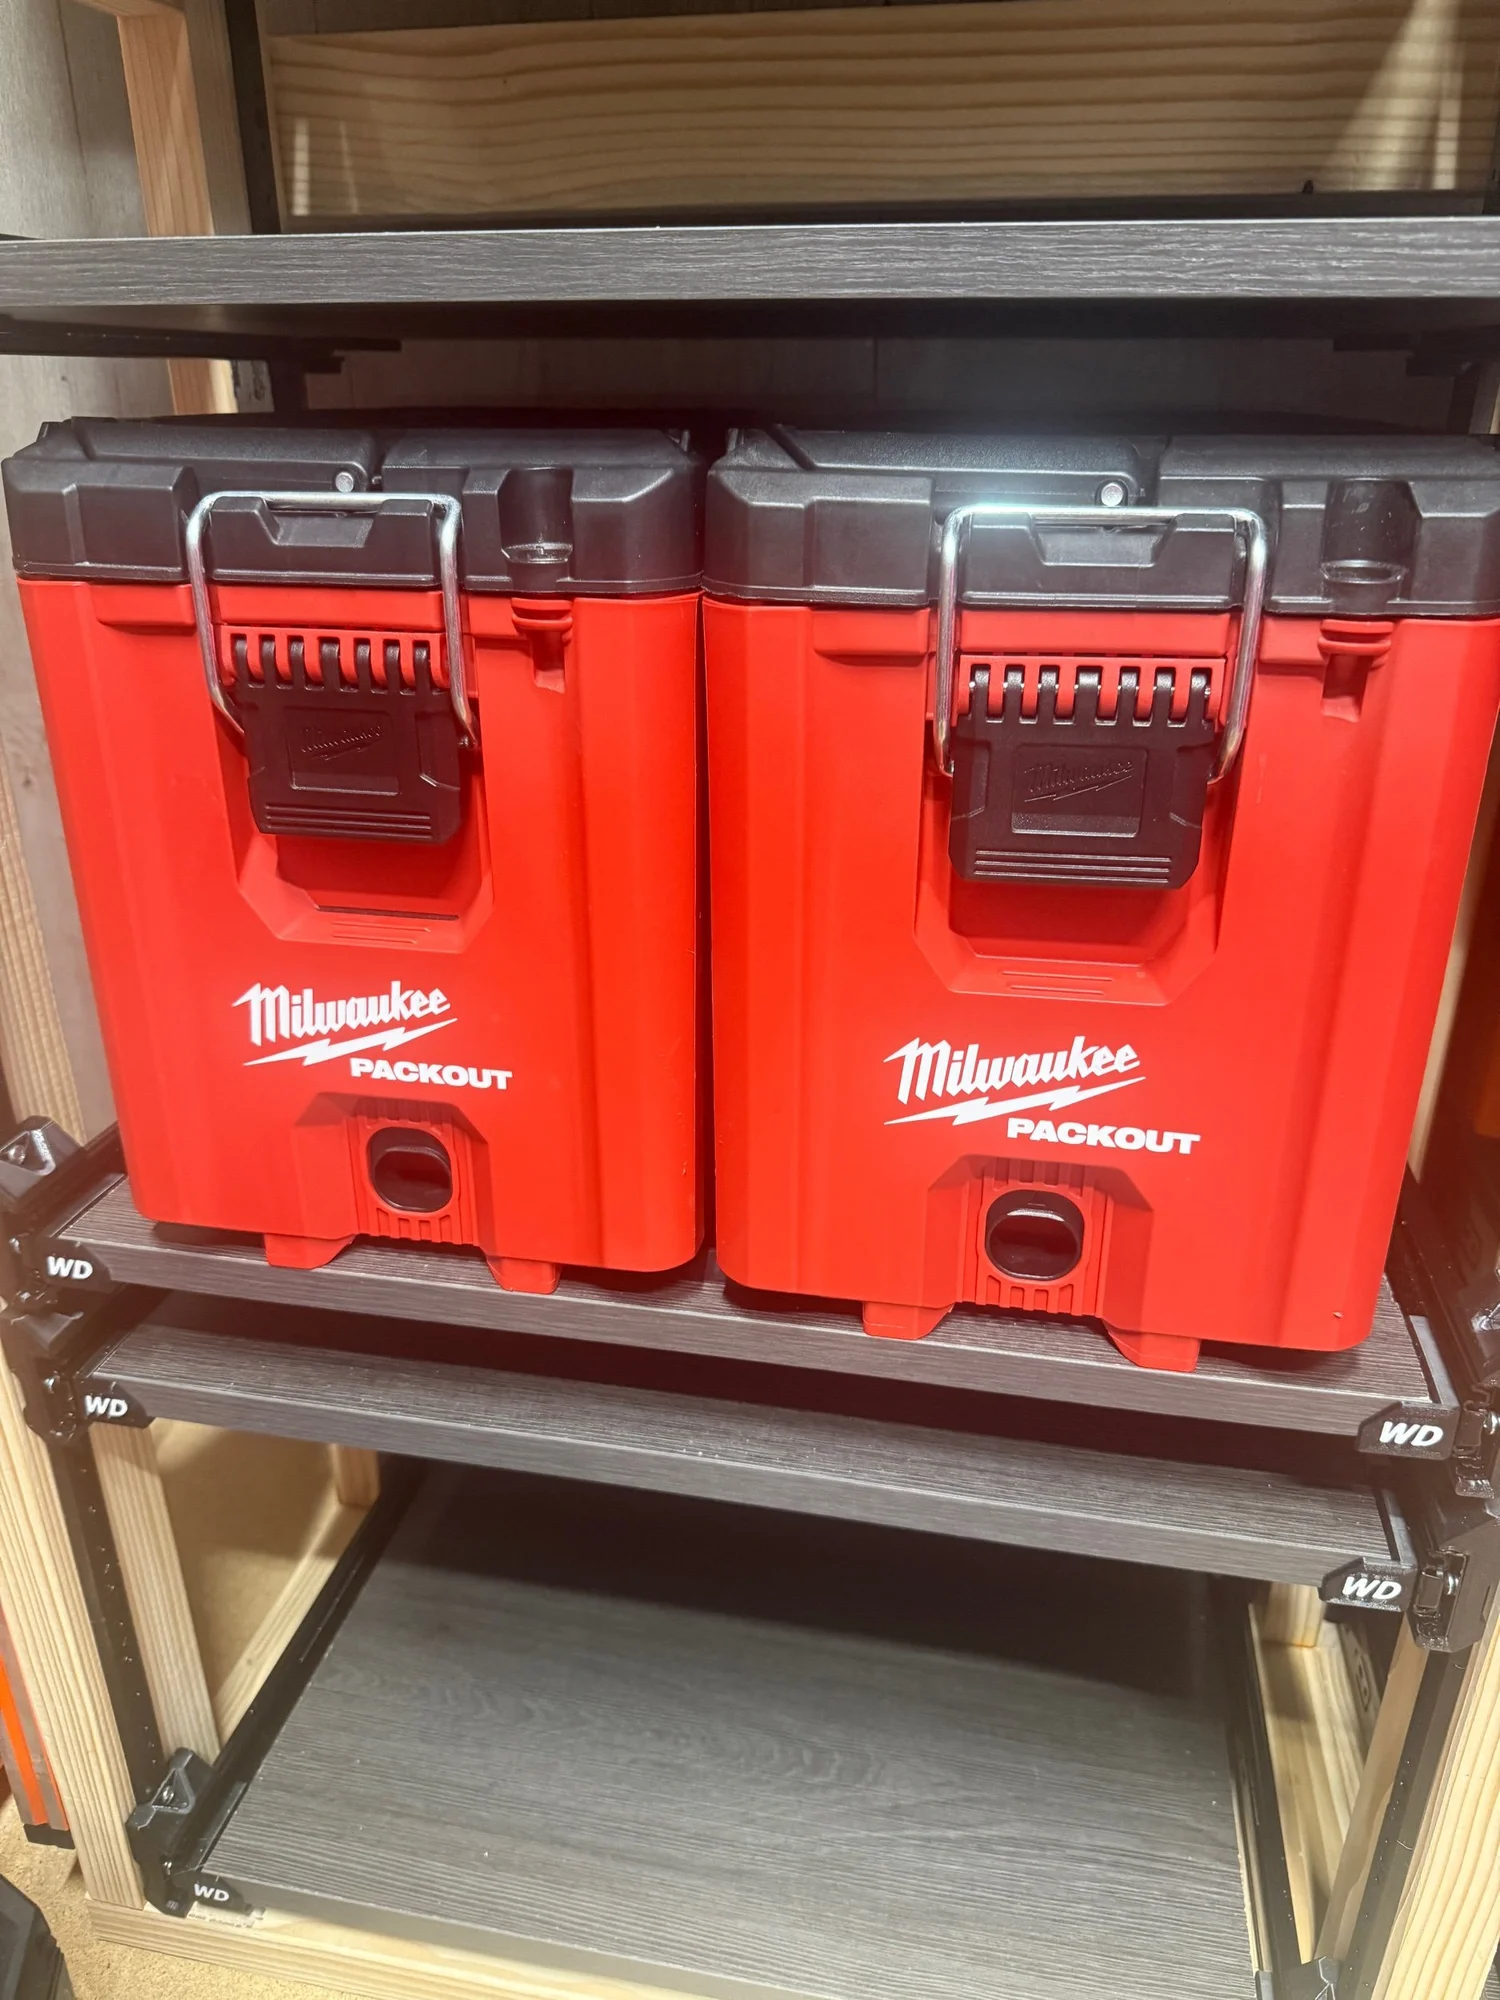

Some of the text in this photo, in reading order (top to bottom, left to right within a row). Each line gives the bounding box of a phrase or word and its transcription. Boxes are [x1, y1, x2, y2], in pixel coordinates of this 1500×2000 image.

[233, 981, 451, 1047] Milwaukee
[350, 1058, 512, 1090] PACKOUT
[884, 1036, 1140, 1104] Milwaukee
[1007, 1118, 1201, 1155] PACKOUT
[47, 1256, 93, 1280] WD
[84, 1395, 128, 1418] WD
[1379, 1421, 1444, 1447] WD
[1341, 1575, 1402, 1600] WD
[193, 1883, 230, 1902] WD
